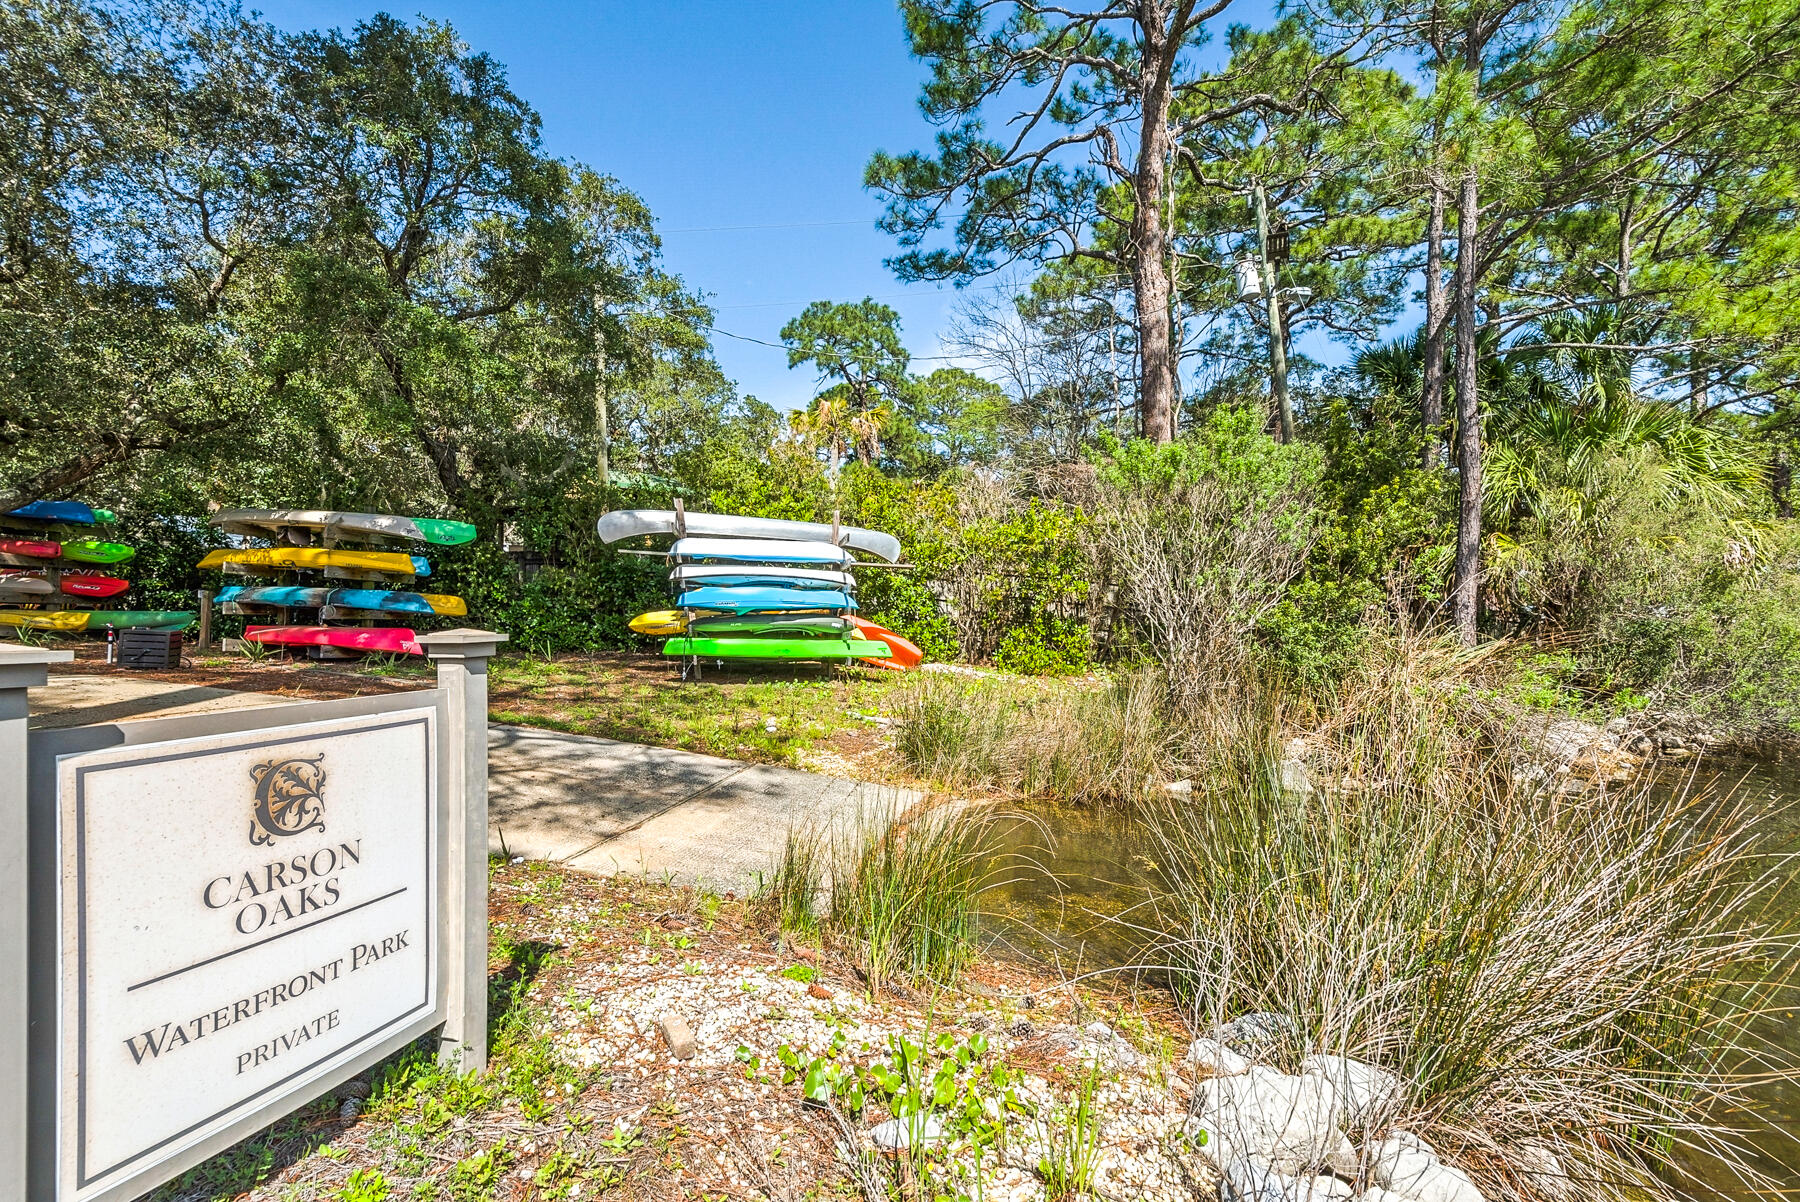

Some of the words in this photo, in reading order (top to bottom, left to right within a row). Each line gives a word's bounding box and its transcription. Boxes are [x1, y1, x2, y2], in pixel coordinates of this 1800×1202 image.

[203, 839, 361, 909] CARSON
[235, 877, 340, 934] OAKS
[123, 959, 343, 1065] WATERFRONT
[350, 930, 410, 972] PARK
[235, 1009, 340, 1076] PRIVATE
